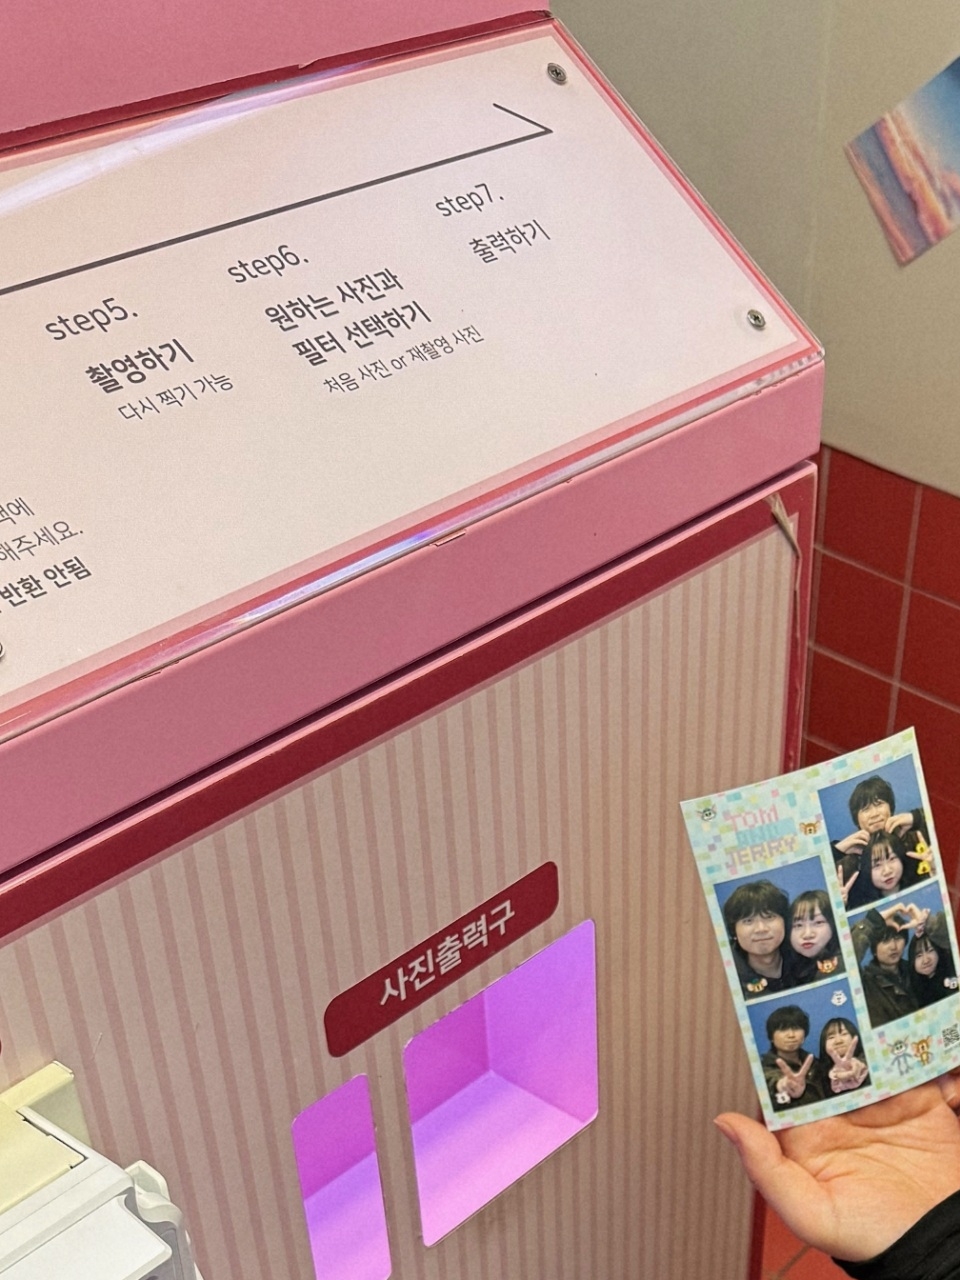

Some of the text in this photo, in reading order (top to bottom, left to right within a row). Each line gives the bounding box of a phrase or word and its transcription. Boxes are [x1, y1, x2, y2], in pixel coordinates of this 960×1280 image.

[435, 183, 504, 217] step7.
[227, 244, 310, 283] step6.
[468, 219, 551, 264] 출력하기
[45, 297, 138, 341] step5.
[264, 268, 404, 332] 원하는 사진과
[292, 300, 432, 367] 필터 선택하기
[85, 338, 195, 394] 촬영하기
[323, 325, 485, 394] 처음 사진 or 재촬영 사진
[117, 373, 234, 420] 다시 찍기 가능
[0, 555, 92, 607] 반환 안됨
[729, 803, 779, 832] TOM
[726, 832, 798, 868] JERRY
[379, 899, 516, 1006] 사진출력구
